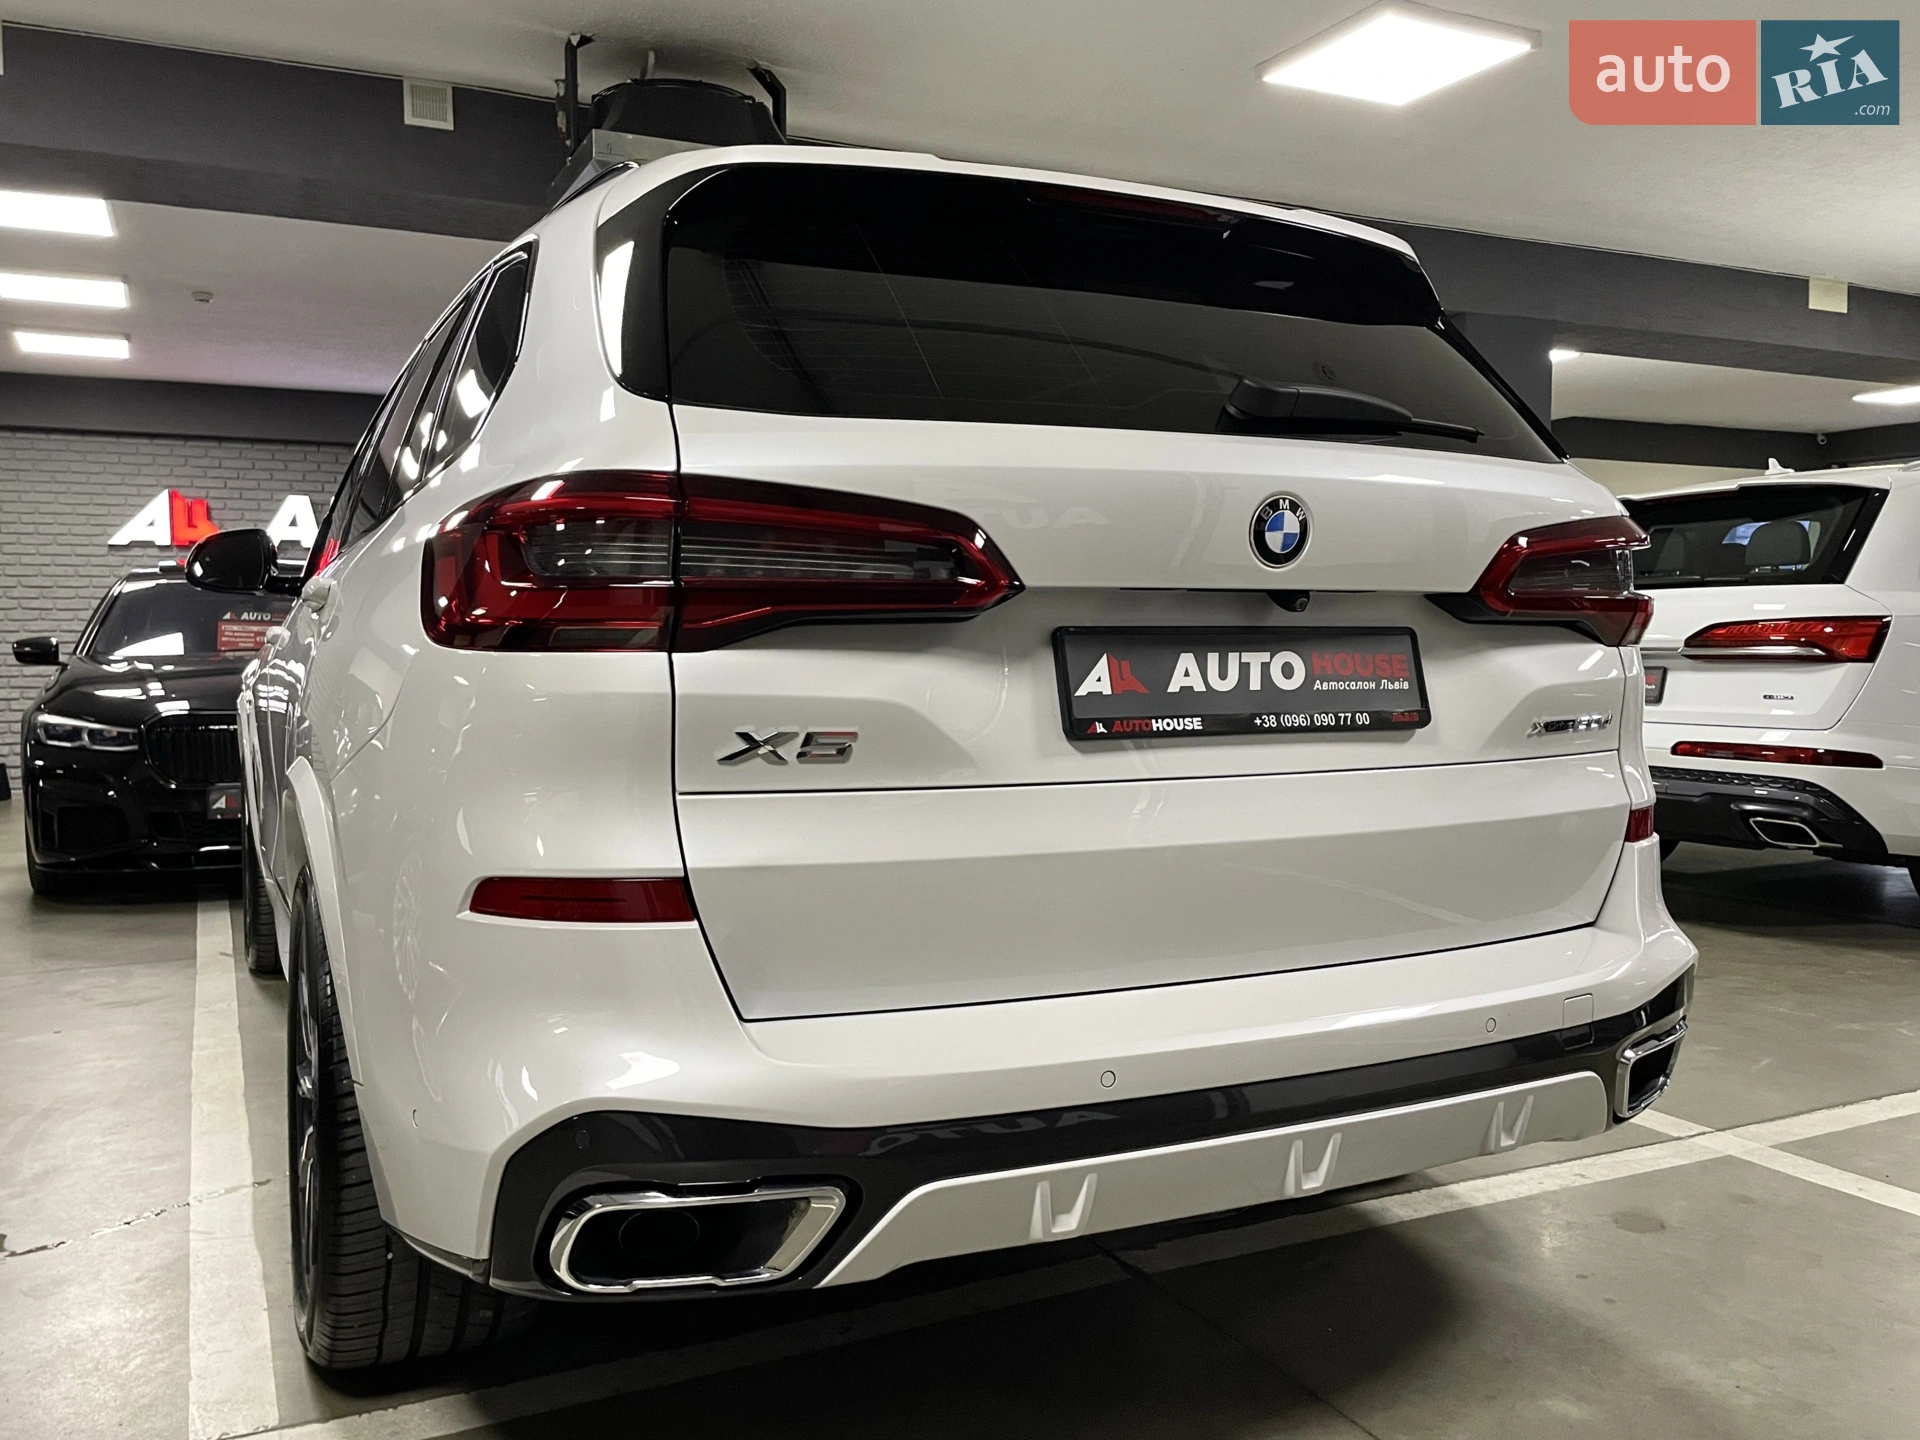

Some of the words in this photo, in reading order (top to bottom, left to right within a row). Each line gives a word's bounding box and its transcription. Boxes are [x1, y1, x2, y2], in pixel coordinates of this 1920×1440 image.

[1260, 498, 1306, 521] BMW
[240, 611, 271, 621] AUTO
[1166, 650, 1306, 693] AUTO
[1310, 650, 1409, 678] HOUSE
[1313, 679, 1376, 691] Автосалон
[1379, 678, 1409, 690] Львів
[1112, 717, 1203, 733] AUTOHOUSE
[1254, 714, 1277, 727] +38
[1280, 713, 1310, 727] (096)
[1313, 713, 1336, 726] 090
[1337, 713, 1352, 725] 77
[1355, 712, 1370, 725] 00
[716, 727, 858, 765] X5
